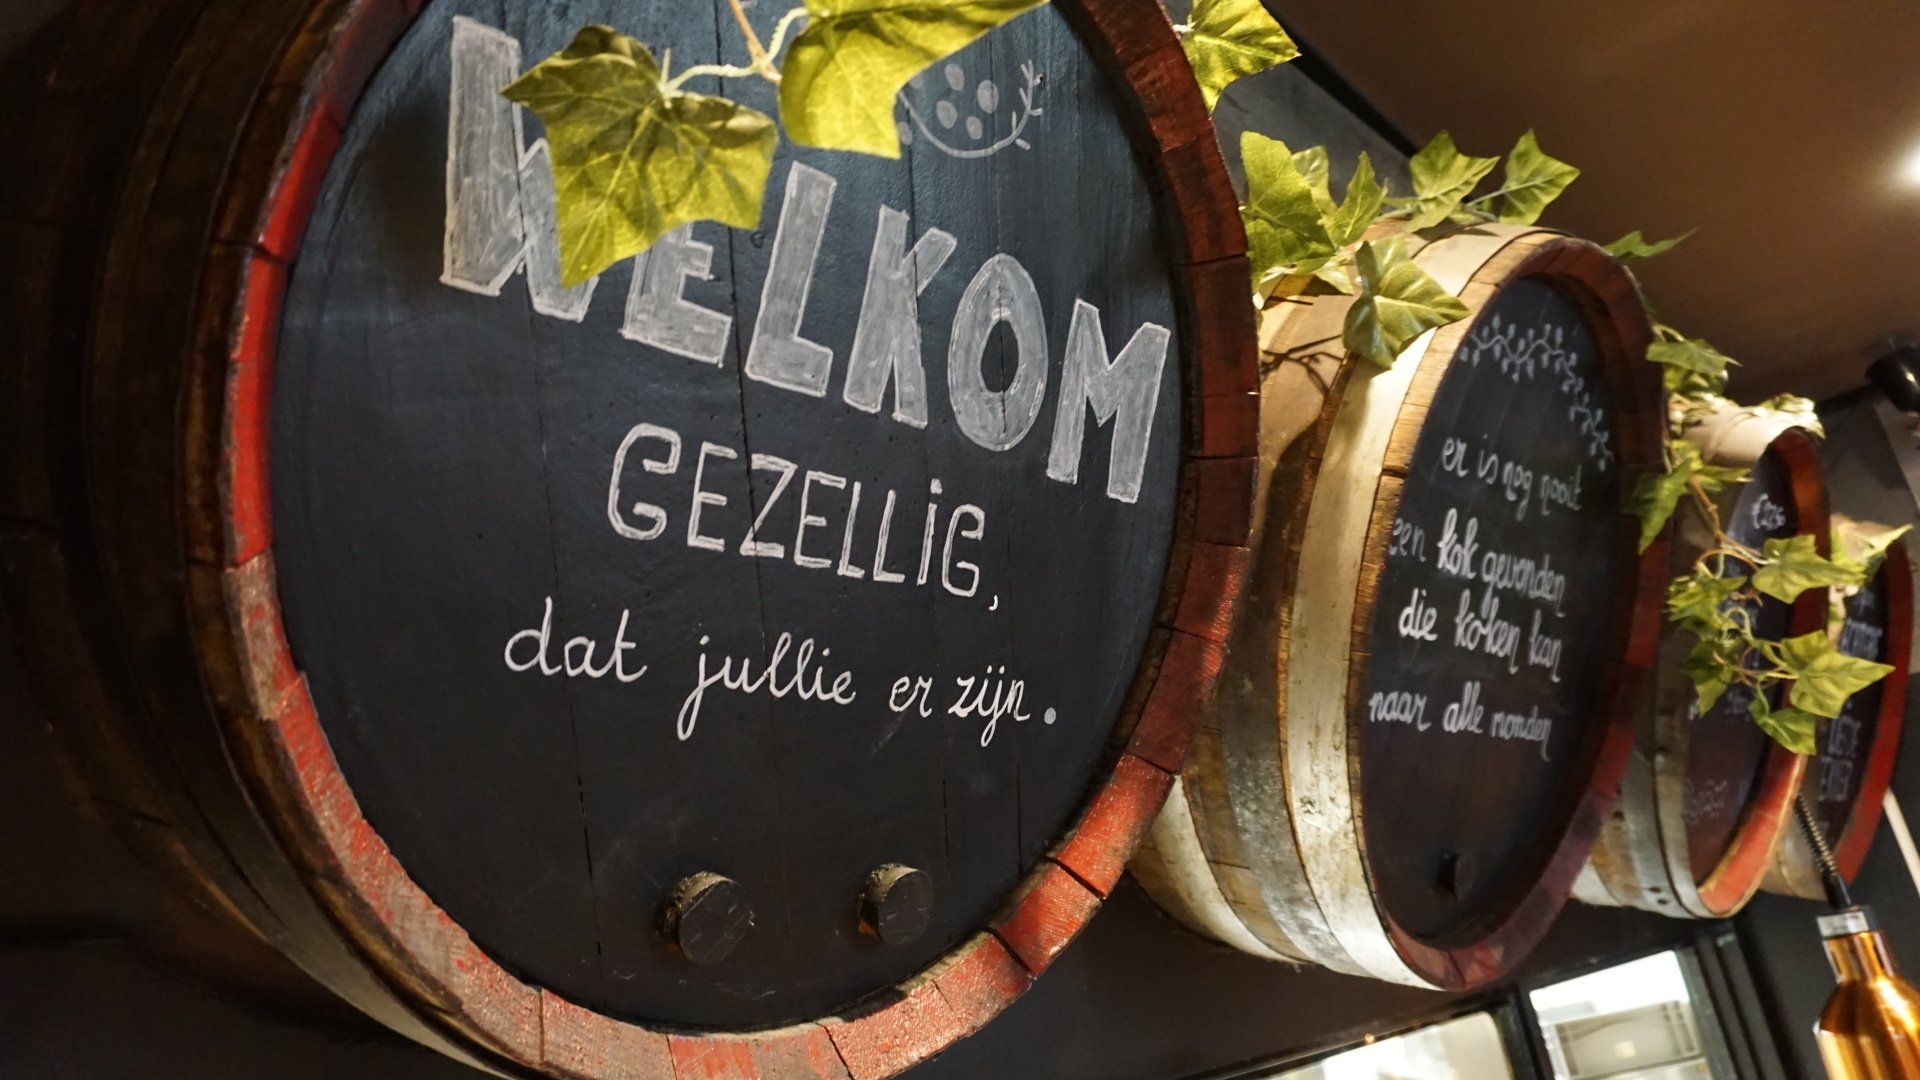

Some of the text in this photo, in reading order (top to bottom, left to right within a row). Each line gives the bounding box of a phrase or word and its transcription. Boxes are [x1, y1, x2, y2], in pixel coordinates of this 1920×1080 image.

[1442, 437, 1469, 477] er
[1478, 433, 1499, 484] is
[1503, 461, 1533, 521] nog
[1437, 508, 1479, 579] kok
[1481, 551, 1565, 618] gevonden
[504, 596, 648, 683] dat
[677, 631, 856, 740] jullie
[889, 673, 932, 718] er
[1399, 588, 1438, 641] die
[1529, 609, 1562, 683] kan
[1368, 691, 1432, 731] naar
[1442, 681, 1484, 733] alle
